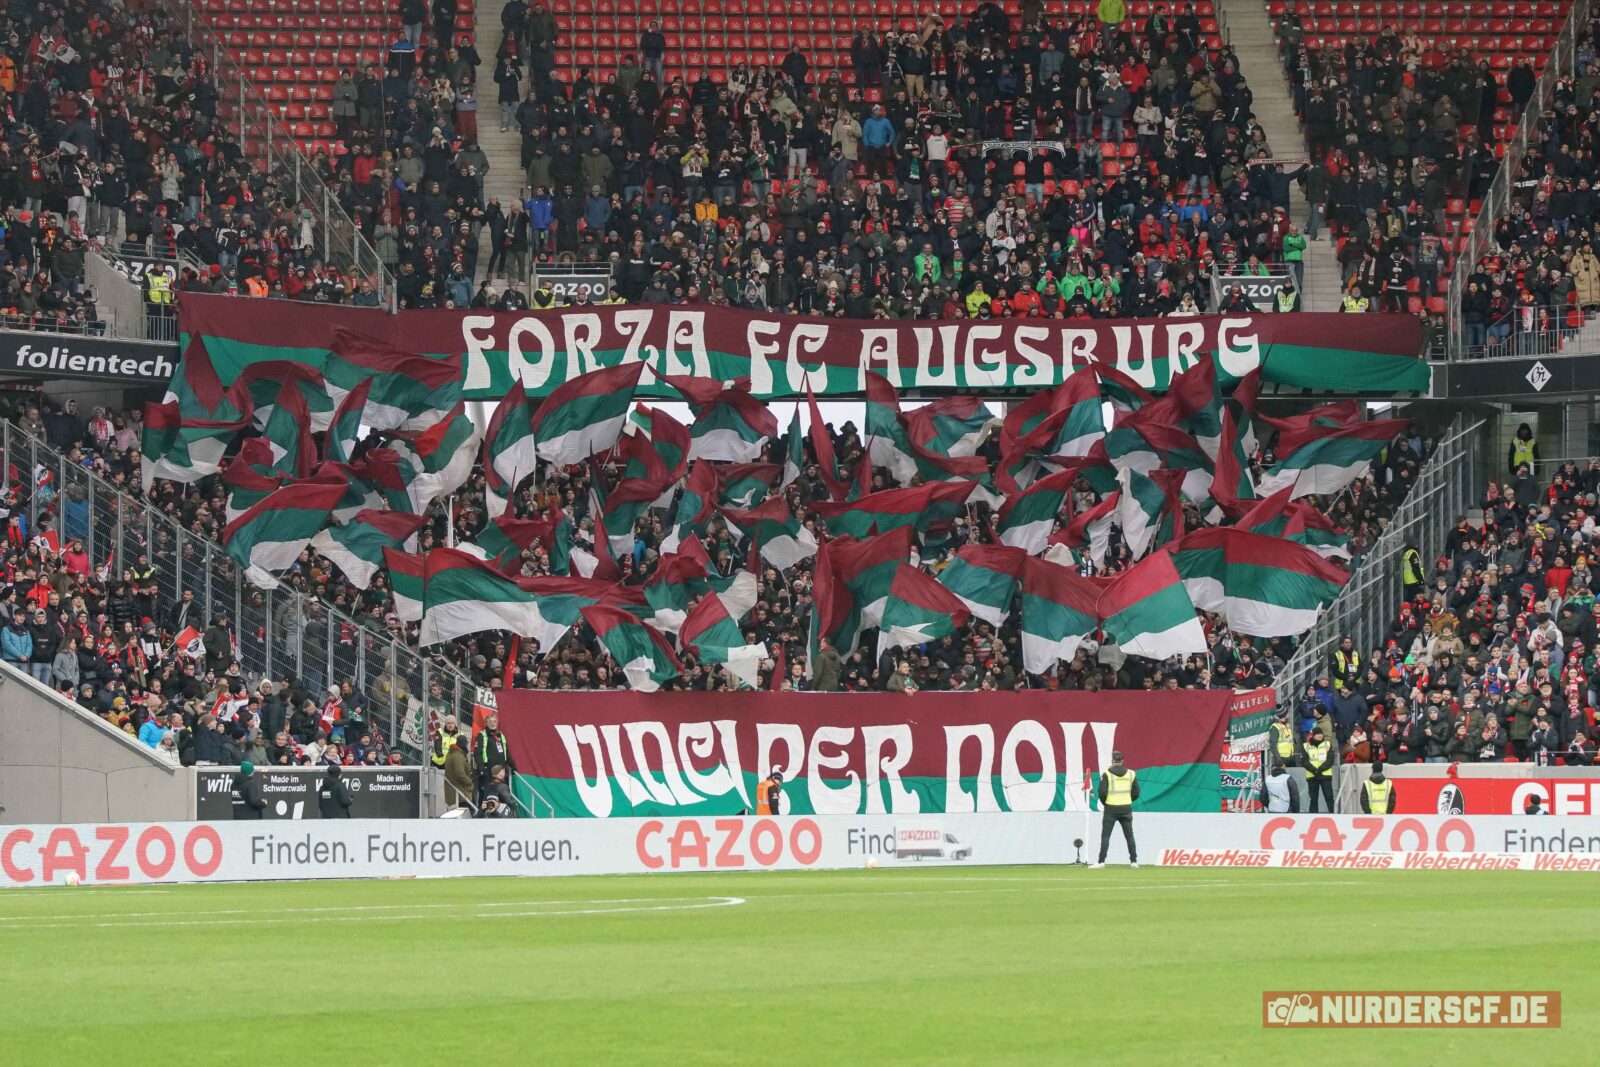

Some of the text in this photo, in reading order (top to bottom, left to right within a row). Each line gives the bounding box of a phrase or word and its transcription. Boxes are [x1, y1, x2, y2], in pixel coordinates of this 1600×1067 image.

[16, 345, 181, 378] folientech
[462, 308, 1261, 394] FORZA FC AUGSBURG
[270, 775, 300, 783] Made im
[376, 774, 404, 782] Made im
[756, 724, 920, 815] PER
[942, 719, 1118, 812] NOI
[207, 773, 233, 793] wih
[262, 783, 307, 792] Schwarzwald
[369, 783, 411, 791] Schwarzwald
[1511, 781, 1600, 815] GE
[636, 818, 823, 869] CAZOO
[1260, 817, 1476, 852] CAZOO
[1, 824, 223, 882] CAZOO
[251, 832, 580, 865] Finden. Fahren. Freuen.
[1162, 849, 1271, 866] WeberHaus
[1281, 850, 1393, 868] WeberHaus
[1404, 852, 1521, 870] WeberHaus
